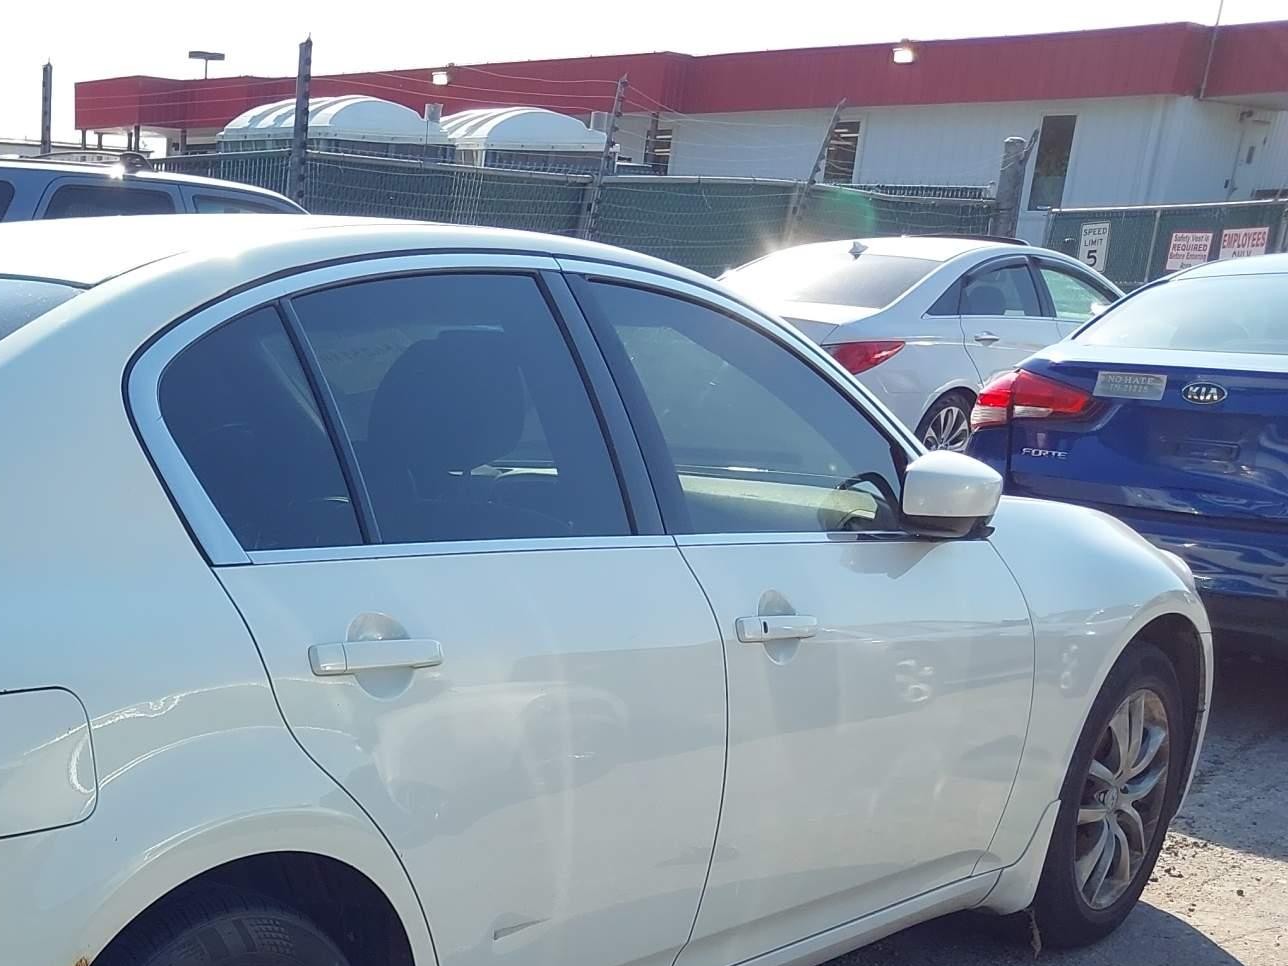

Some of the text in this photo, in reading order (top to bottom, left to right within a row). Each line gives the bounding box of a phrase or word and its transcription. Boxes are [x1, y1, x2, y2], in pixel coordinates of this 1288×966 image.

[1083, 227, 1107, 236] SPEED
[1084, 238, 1103, 247] LIMIT
[1222, 231, 1267, 248] EMPLOYEES
[1172, 243, 1208, 252] REQUIRED
[1087, 250, 1097, 267] 5
[1107, 375, 1155, 386] NO HATE
[1187, 386, 1218, 401] KIA
[1021, 447, 1069, 459] FORTE
